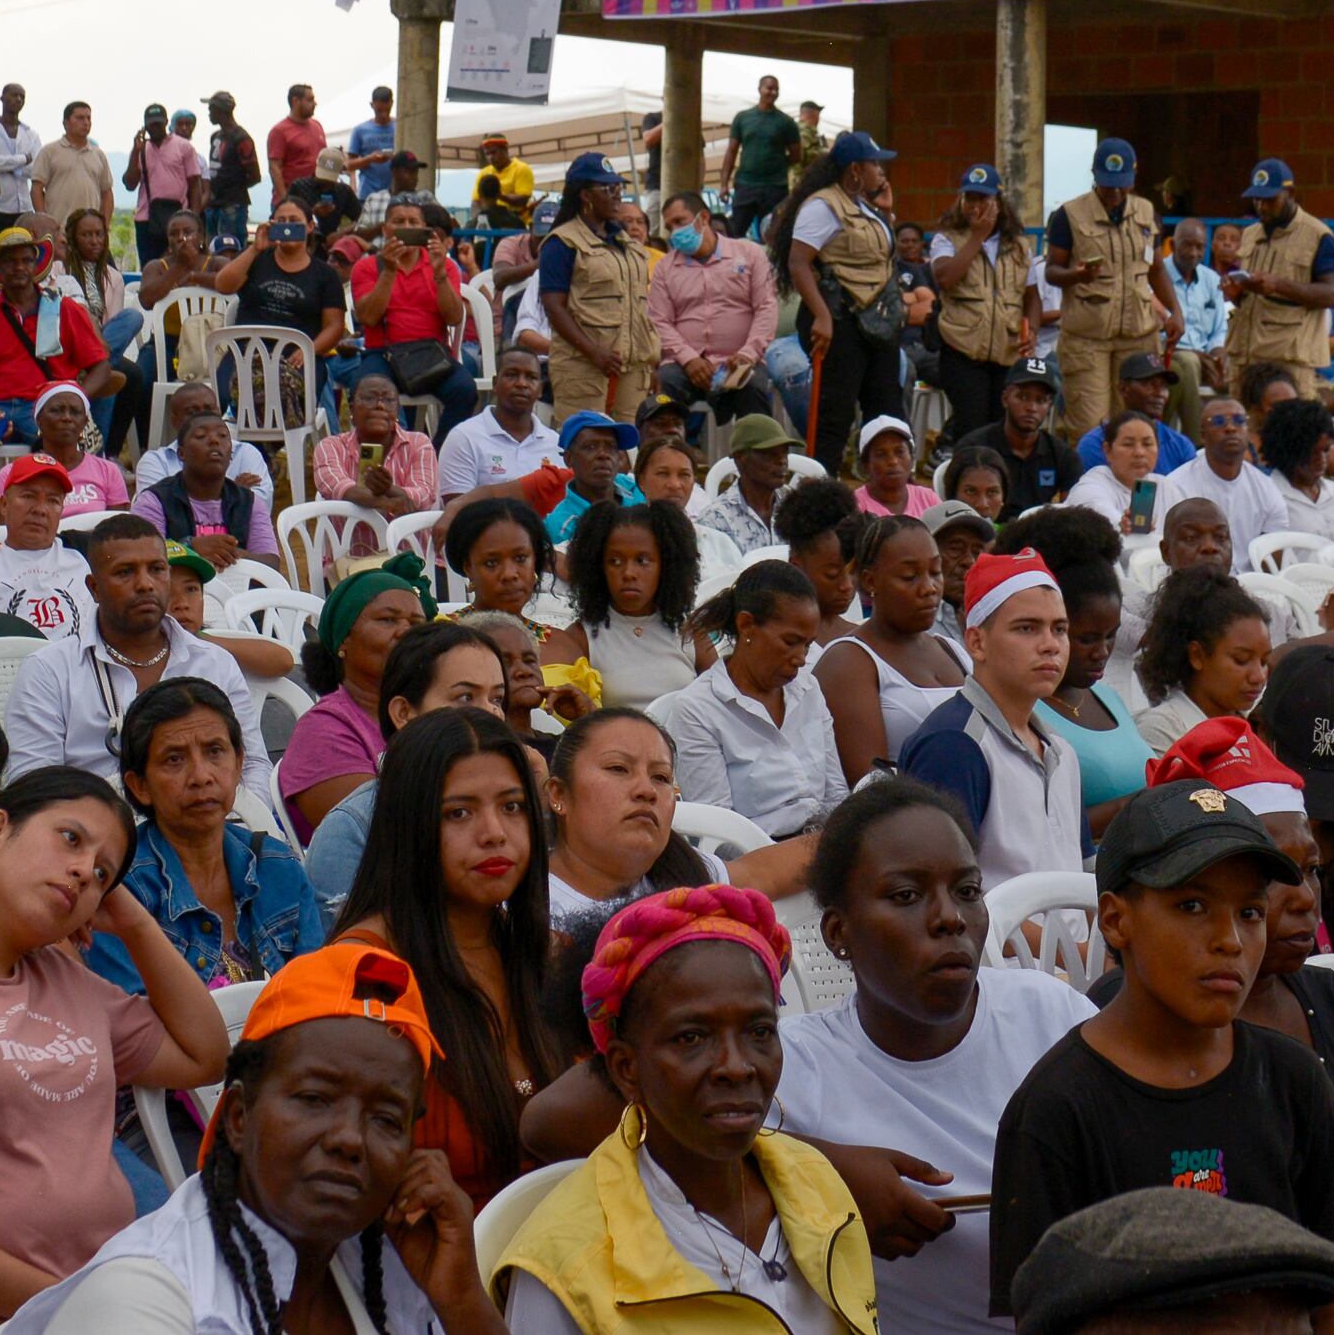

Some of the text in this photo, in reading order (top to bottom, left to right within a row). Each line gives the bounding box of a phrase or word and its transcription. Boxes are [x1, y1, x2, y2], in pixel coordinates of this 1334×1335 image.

[30, 1080, 62, 1103] MADE
[64, 1083, 85, 1102] ARE
[1170, 1148, 1219, 1175] you
[1193, 1168, 1210, 1183] are
